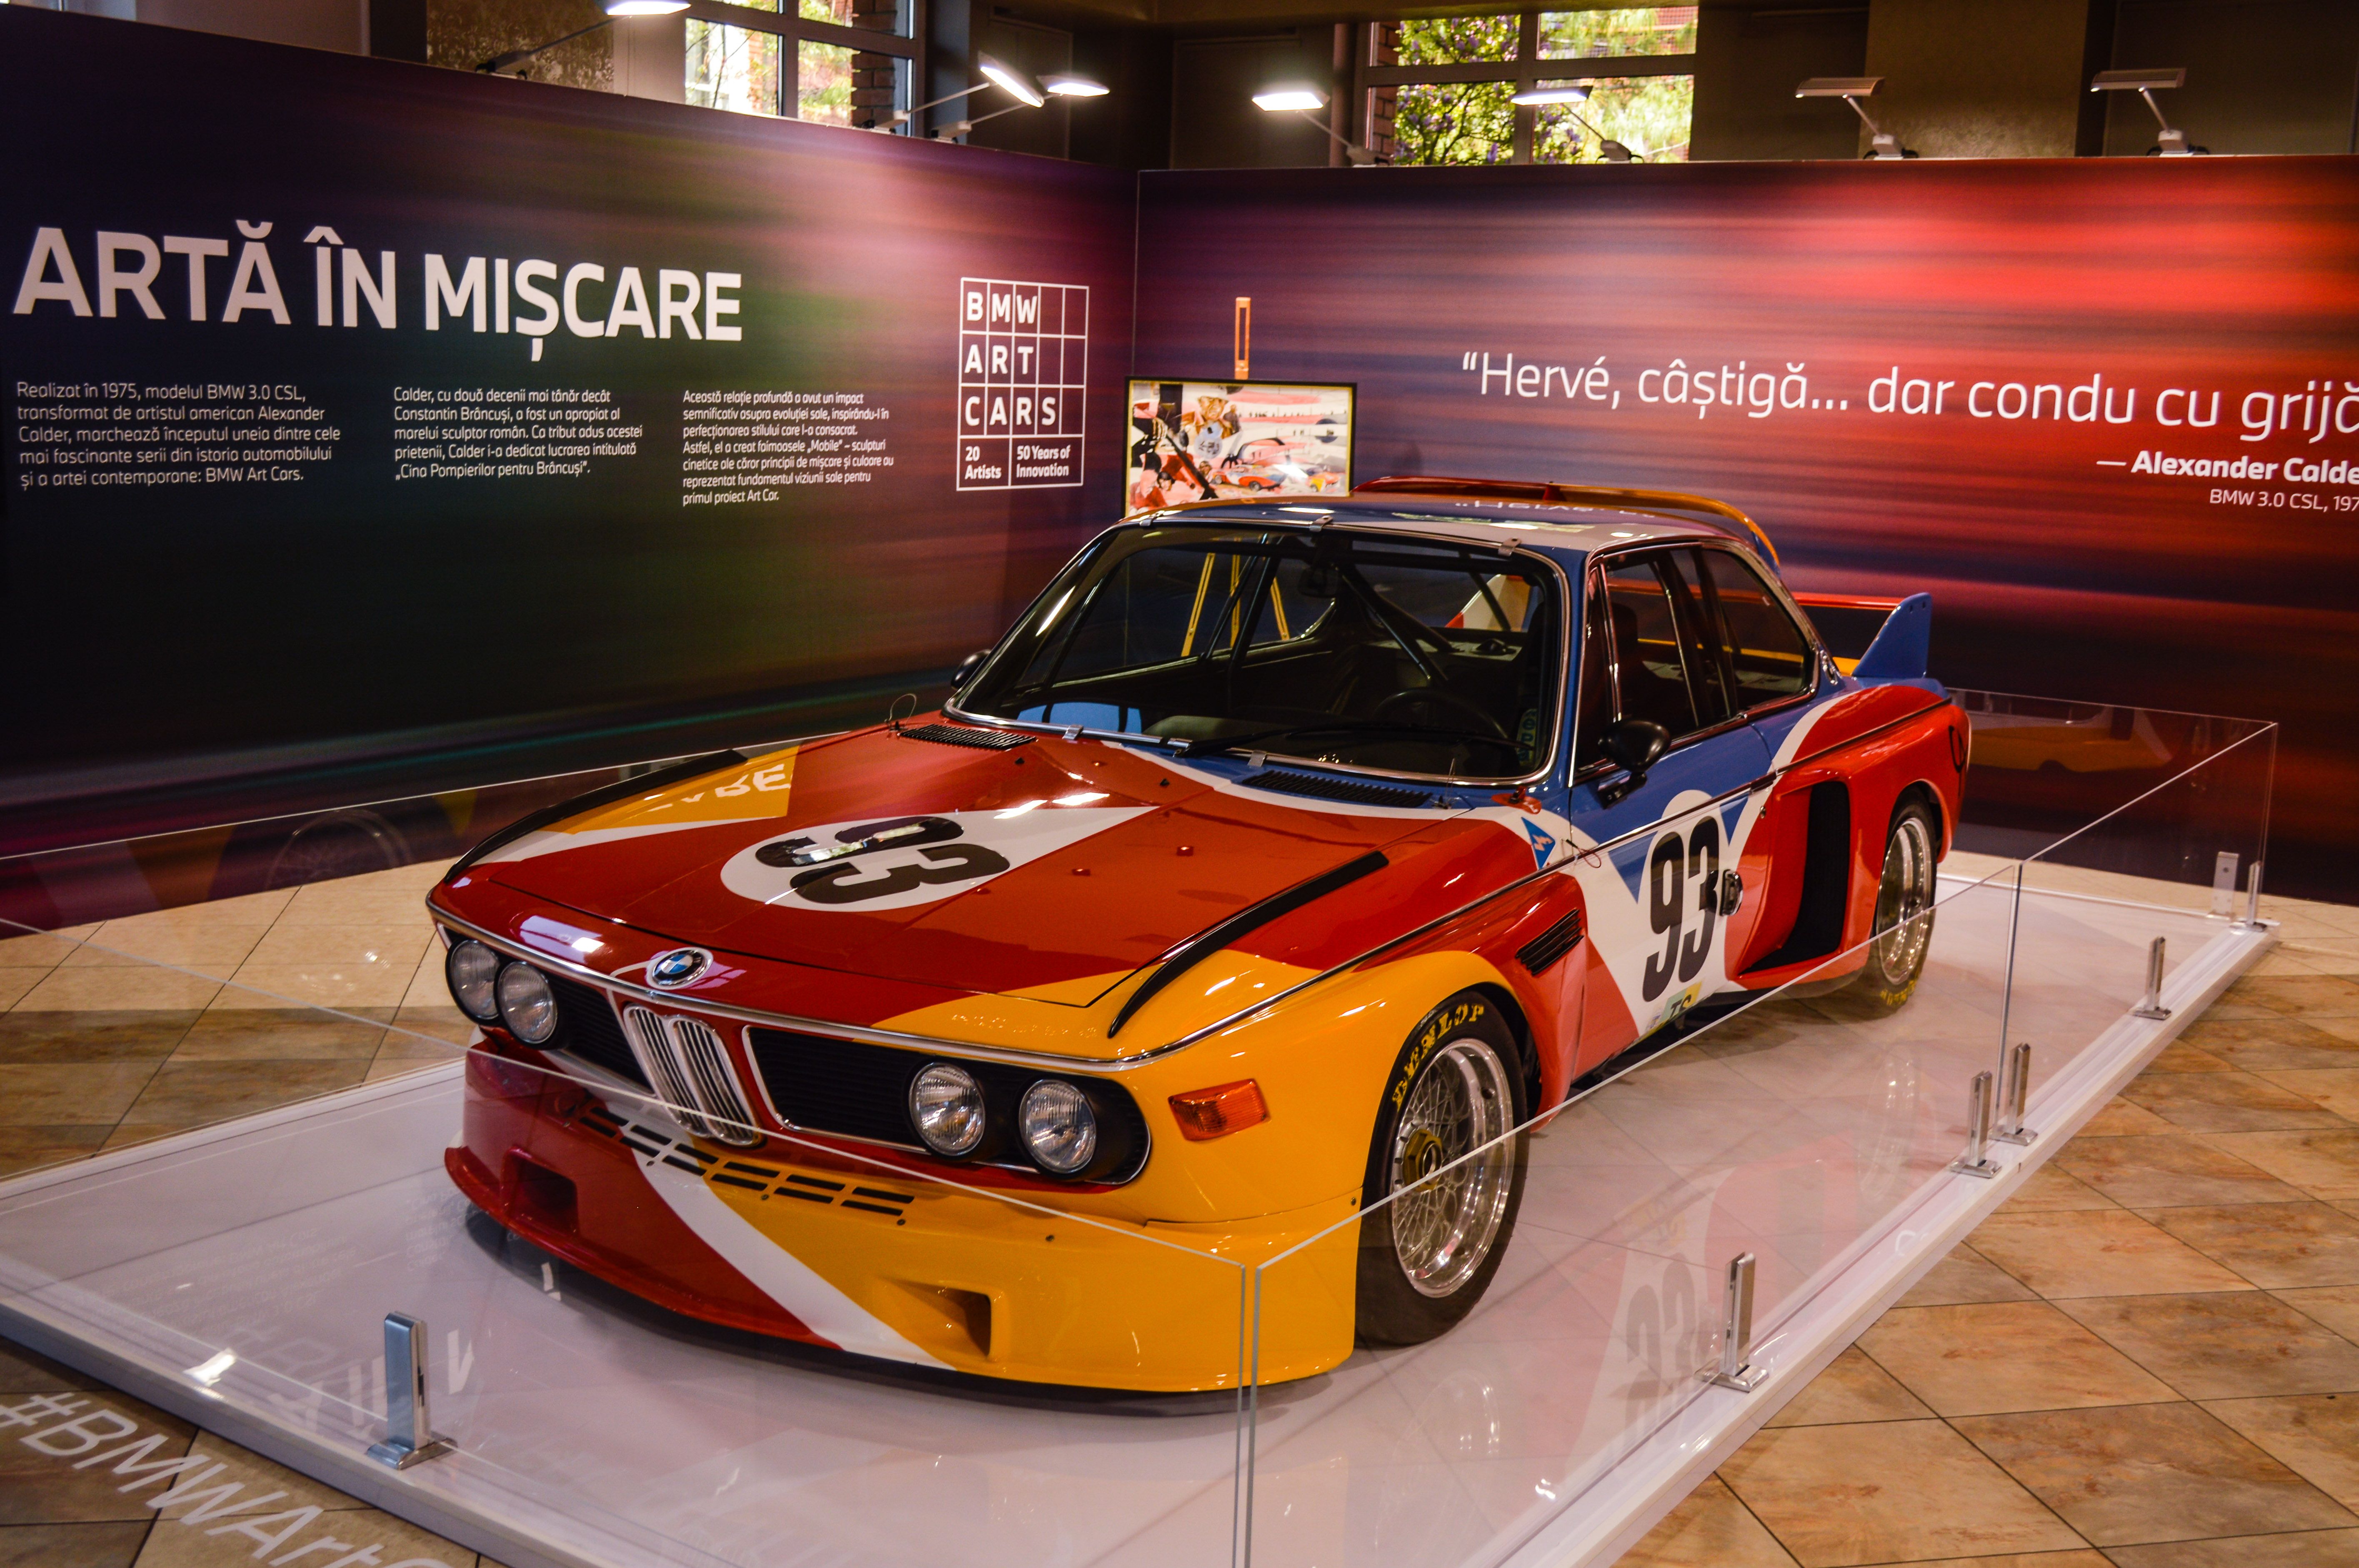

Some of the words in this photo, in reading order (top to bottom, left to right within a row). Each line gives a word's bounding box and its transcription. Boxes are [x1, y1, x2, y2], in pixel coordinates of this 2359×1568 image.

[13, 220, 291, 324] ARTĂ
[304, 226, 396, 329] ÎN
[425, 254, 742, 361] MIȘCARE
[967, 291, 1037, 323] BMW
[964, 344, 1033, 375] ART
[18, 382, 80, 397] Realizat
[84, 384, 98, 398] în
[102, 383, 140, 400] 1975,
[146, 385, 202, 399] modelul
[208, 385, 245, 399] BMW
[249, 385, 270, 399] 3.0
[275, 385, 305, 402] CSL,
[394, 387, 434, 403] Calder,
[438, 391, 450, 401] cu
[454, 388, 483, 401] două
[487, 389, 525, 402] decenii
[529, 390, 548, 402] mai
[552, 389, 579, 402] tânăr
[582, 390, 610, 402] decât
[683, 390, 721, 403] Această
[754, 391, 793, 405] profundă
[795, 394, 801, 403] a
[803, 393, 821, 403] avut
[823, 394, 834, 404] un
[836, 392, 864, 406] impact
[1869, 366, 1954, 414] dar
[1969, 373, 2134, 423] condu
[2156, 389, 2219, 427] cu
[18, 405, 108, 419] transformat
[114, 406, 131, 419] de
[137, 406, 185, 420] artistul
[190, 409, 253, 420] american
[258, 406, 325, 420] Alexander
[395, 406, 457, 420] Constantin
[461, 407, 513, 424] Brâncuși,
[516, 410, 523, 420] a
[526, 407, 546, 420] fost
[549, 410, 562, 420] un
[565, 407, 608, 422] apropiat
[611, 408, 619, 420] al
[683, 407, 738, 419] semnificativ
[740, 410, 770, 422] asupra
[811, 408, 830, 421] sale,
[881, 408, 889, 419] în
[965, 396, 1056, 426] CARS
[20, 426, 71, 444] Calder,
[77, 427, 159, 441] marchează
[163, 427, 228, 443] începutul
[233, 427, 269, 440] uneia
[274, 427, 310, 440] dintre
[315, 427, 340, 440] cele
[395, 426, 438, 439] marelui
[442, 426, 488, 441] sculptor
[490, 426, 528, 439] român.
[532, 425, 545, 438] Ca
[549, 426, 576, 438] tribut
[579, 425, 604, 438] adus
[607, 425, 642, 437] acestei
[683, 424, 749, 439] perfecționarea
[751, 424, 779, 436] stilului
[781, 426, 800, 436] care
[802, 424, 813, 435] l-a
[816, 425, 858, 435] consacrat.
[20, 449, 48, 464] mai
[54, 449, 132, 463] fascinante
[137, 448, 165, 462] serii
[171, 448, 192, 462] din
[197, 447, 238, 462] istoria
[243, 447, 331, 461] automobilului
[395, 445, 445, 461] prietenii,
[449, 444, 485, 458] Calder
[488, 444, 502, 457] i-a
[506, 444, 545, 457] dedicat
[549, 444, 590, 456] lucrarea
[593, 442, 636, 455] intitulată
[683, 441, 712, 455] Astfel,
[715, 441, 723, 453] el
[725, 443, 731, 453] a
[733, 442, 756, 452] creat
[758, 440, 805, 452] faimoasele
[852, 439, 886, 452] sculpturi
[966, 446, 980, 461] 20
[1017, 445, 1030, 460] 50
[1031, 446, 1059, 459] Years
[1060, 445, 1071, 459] of
[431, 463, 495, 479] Pompierilor
[498, 464, 533, 478] pentru
[683, 458, 718, 471] cinetice
[721, 458, 734, 469] ale
[737, 457, 760, 469] căror
[761, 456, 794, 470] principii
[796, 456, 807, 468] de
[809, 458, 842, 470] mișcare
[844, 455, 851, 469] și
[853, 455, 882, 466] culoare
[883, 457, 893, 466] au
[965, 464, 1001, 479] Artists
[1017, 463, 1068, 477] Innovation
[2131, 451, 2278, 479] Alexander
[21, 472, 33, 490] și
[39, 474, 47, 486] a
[53, 471, 86, 485] artei
[91, 469, 201, 486] contemporane:
[206, 468, 243, 482] BMW
[247, 467, 267, 481] Art
[271, 467, 303, 481] Cars.
[683, 475, 736, 489] reprezentat
[738, 472, 793, 485] fundamentul
[795, 472, 823, 483] viziunii
[826, 471, 843, 483] sale
[845, 472, 871, 484] pentru
[683, 492, 712, 507] primul
[715, 491, 745, 505] proiect
[747, 490, 760, 501] Art
[763, 489, 779, 501] Car.
[2210, 489, 2254, 505] BMW
[2258, 492, 2284, 507] 3.0
[2290, 494, 2327, 512] CSL,
[1642, 816, 1719, 1002] 93
[0, 1392, 452, 1568] #BMWArt
